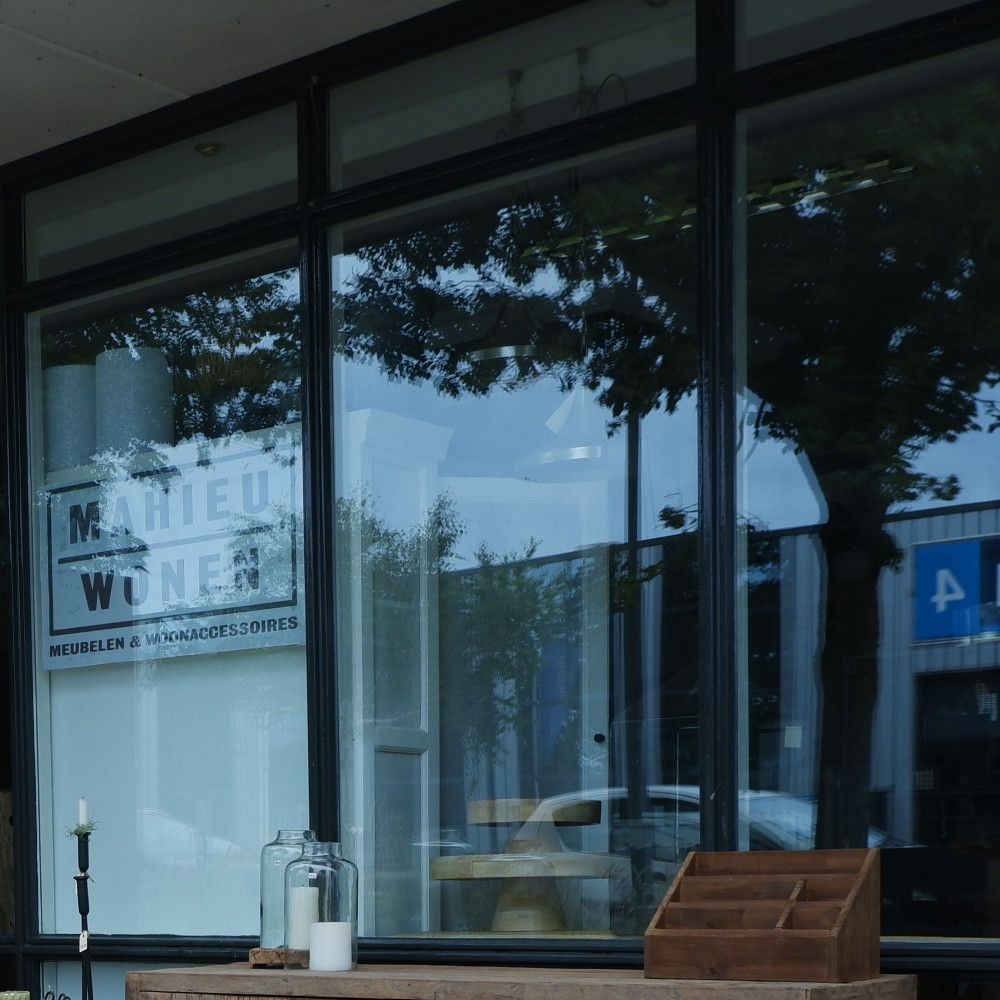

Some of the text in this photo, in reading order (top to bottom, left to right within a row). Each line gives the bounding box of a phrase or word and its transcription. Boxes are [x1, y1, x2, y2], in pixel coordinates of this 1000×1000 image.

[69, 469, 269, 544] MAHIEU
[80, 547, 259, 612] WONEN
[49, 616, 298, 657] MEUBELEN & WOONACCESSOIRES
